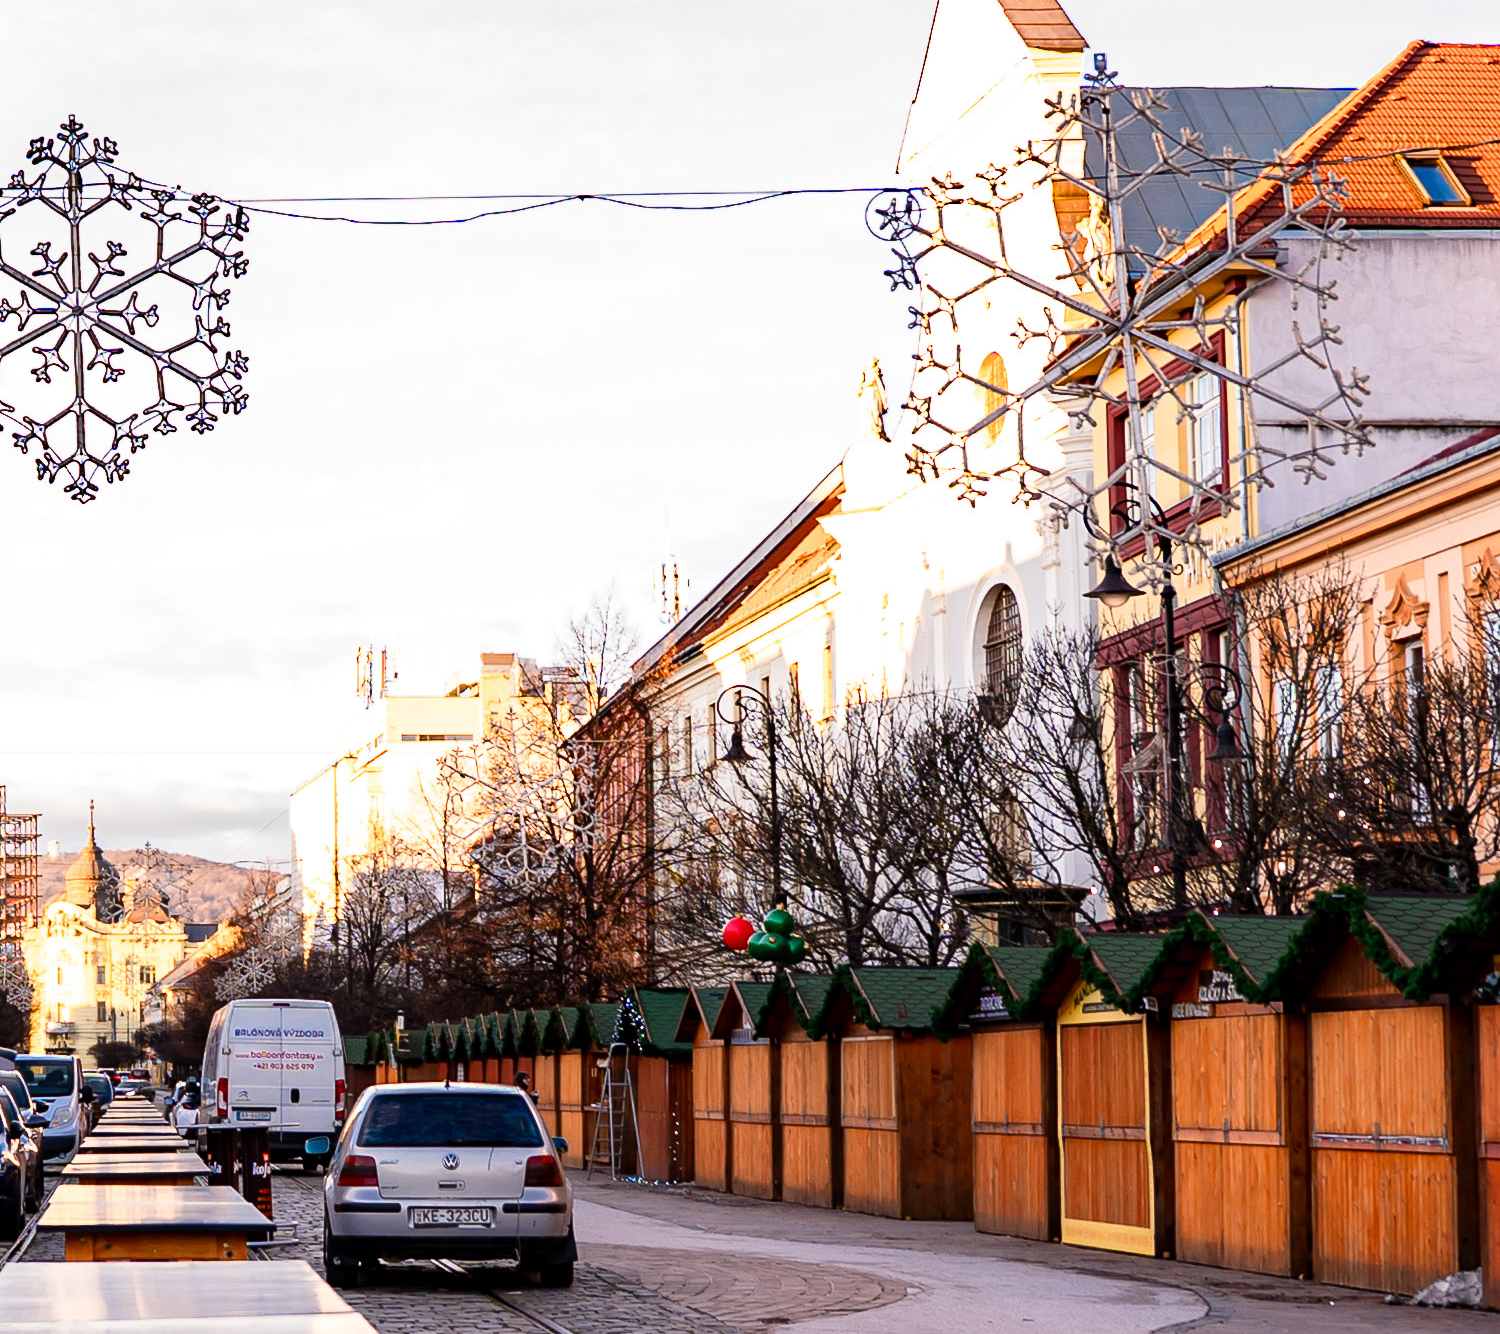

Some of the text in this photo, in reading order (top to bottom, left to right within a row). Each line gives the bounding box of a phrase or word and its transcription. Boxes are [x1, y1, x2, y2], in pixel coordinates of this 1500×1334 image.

[235, 1028, 324, 1038] BALÓNOVÁ VÝZDOBA
[422, 1208, 490, 1224] KE-323CU
